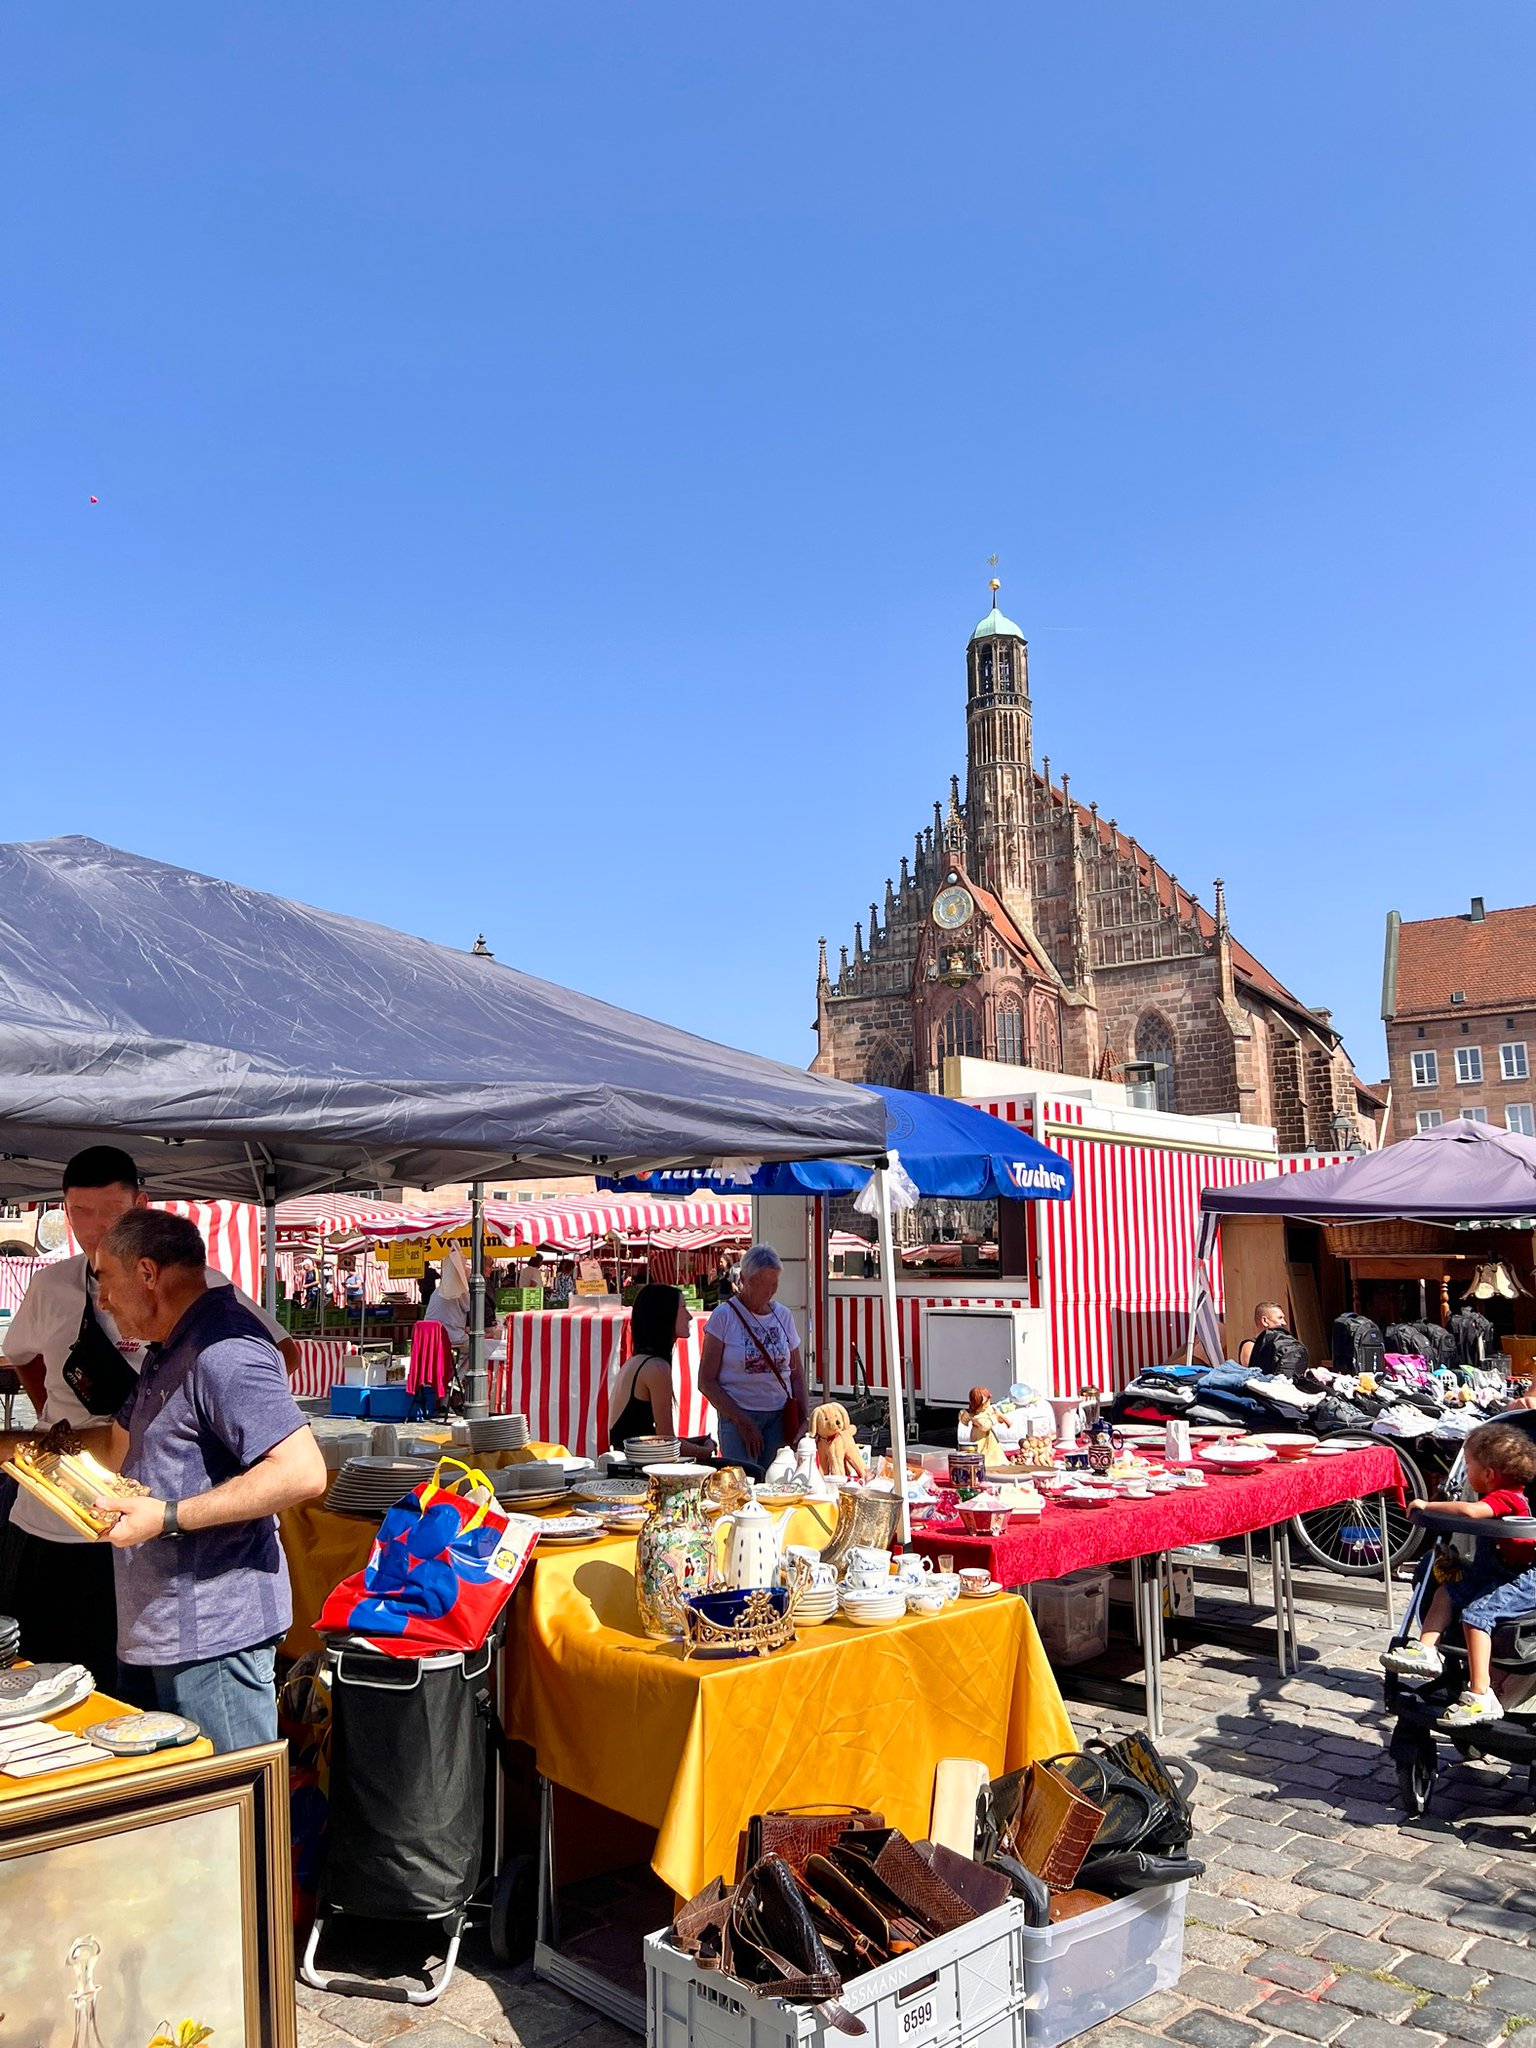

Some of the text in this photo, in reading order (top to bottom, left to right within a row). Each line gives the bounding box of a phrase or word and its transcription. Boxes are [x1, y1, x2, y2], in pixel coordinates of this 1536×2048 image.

[1012, 1162, 1066, 1191] Tucher
[843, 1965, 908, 2009] OSSMANN
[903, 2001, 932, 2033] 8599
